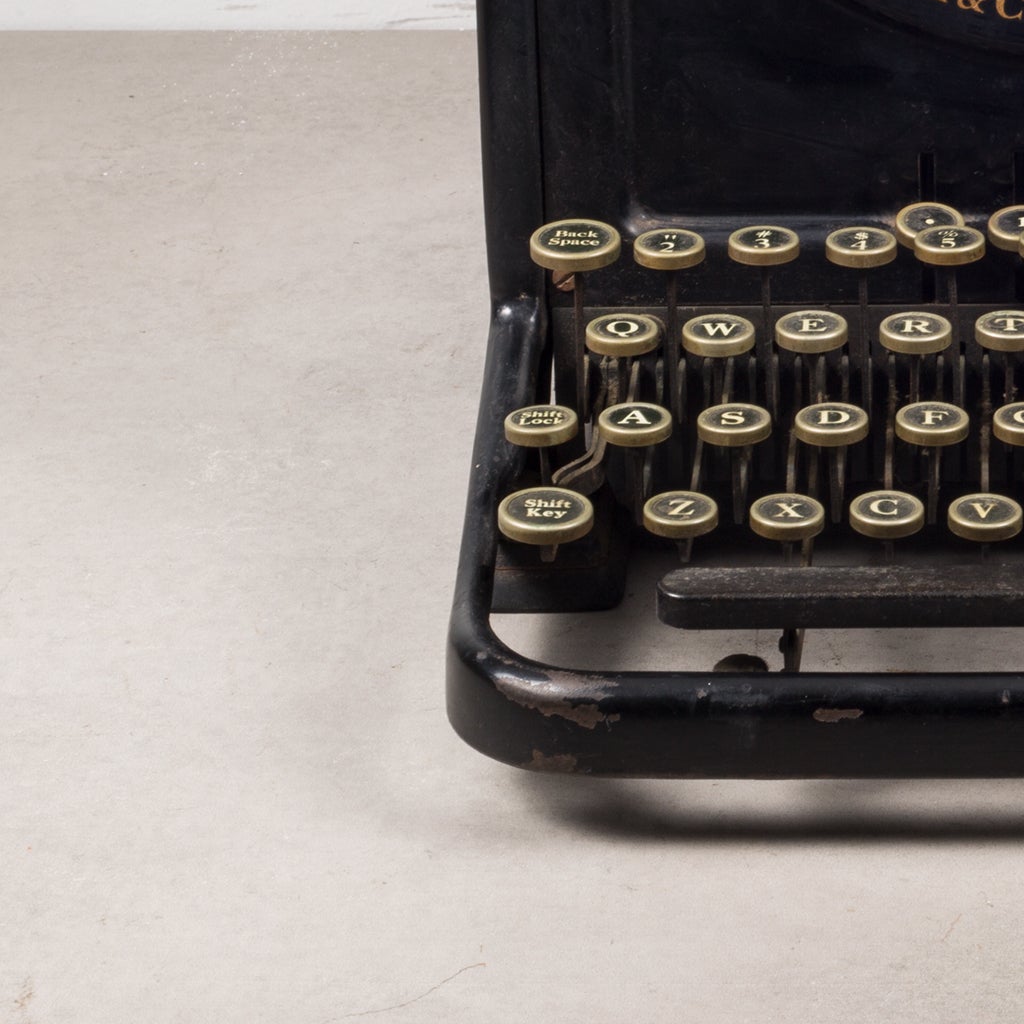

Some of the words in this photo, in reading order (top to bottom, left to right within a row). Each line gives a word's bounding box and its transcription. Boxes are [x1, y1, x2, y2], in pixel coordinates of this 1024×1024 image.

[554, 229, 599, 239] Back
[755, 230, 772, 238] #
[854, 231, 869, 241] $
[548, 237, 600, 247] Space
[660, 242, 675, 253] 2
[754, 238, 770, 249] 3
[851, 240, 867, 251] 4
[940, 237, 957, 248] 5
[606, 320, 640, 338] Q
[702, 322, 738, 337] W
[798, 318, 828, 333] E
[900, 319, 933, 334] R
[520, 410, 565, 419] Shift
[617, 409, 652, 425] A
[720, 410, 745, 425] S
[817, 409, 850, 425] D
[921, 410, 949, 425] F
[519, 417, 564, 426] Lock
[524, 498, 572, 510] Shift
[667, 500, 695, 517] Z
[775, 502, 805, 518] X
[869, 499, 899, 515] C
[526, 508, 568, 519] Key
[970, 503, 998, 519] V
